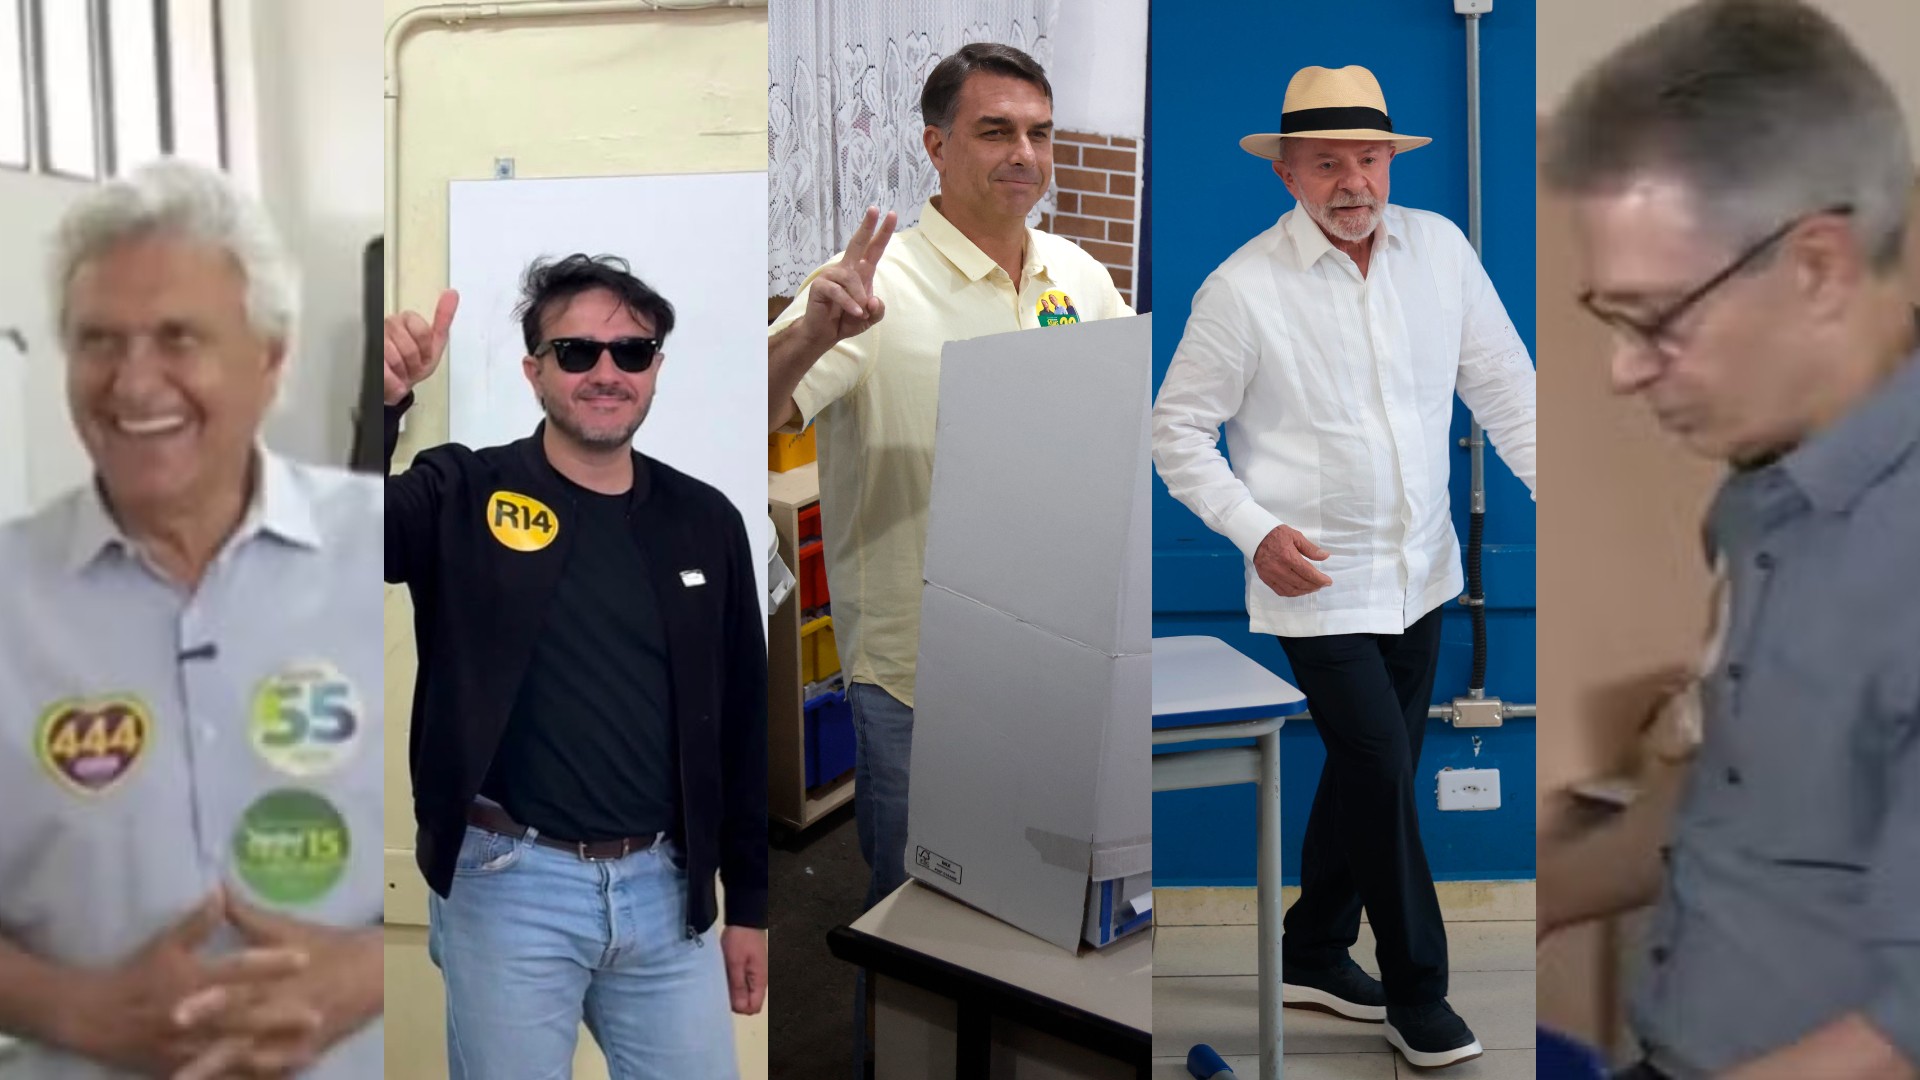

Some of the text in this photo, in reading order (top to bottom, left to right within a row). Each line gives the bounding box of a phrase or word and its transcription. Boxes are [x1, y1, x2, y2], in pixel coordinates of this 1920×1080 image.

[495, 498, 553, 534] R14
[52, 714, 136, 757] 444
[261, 682, 357, 746] 55
